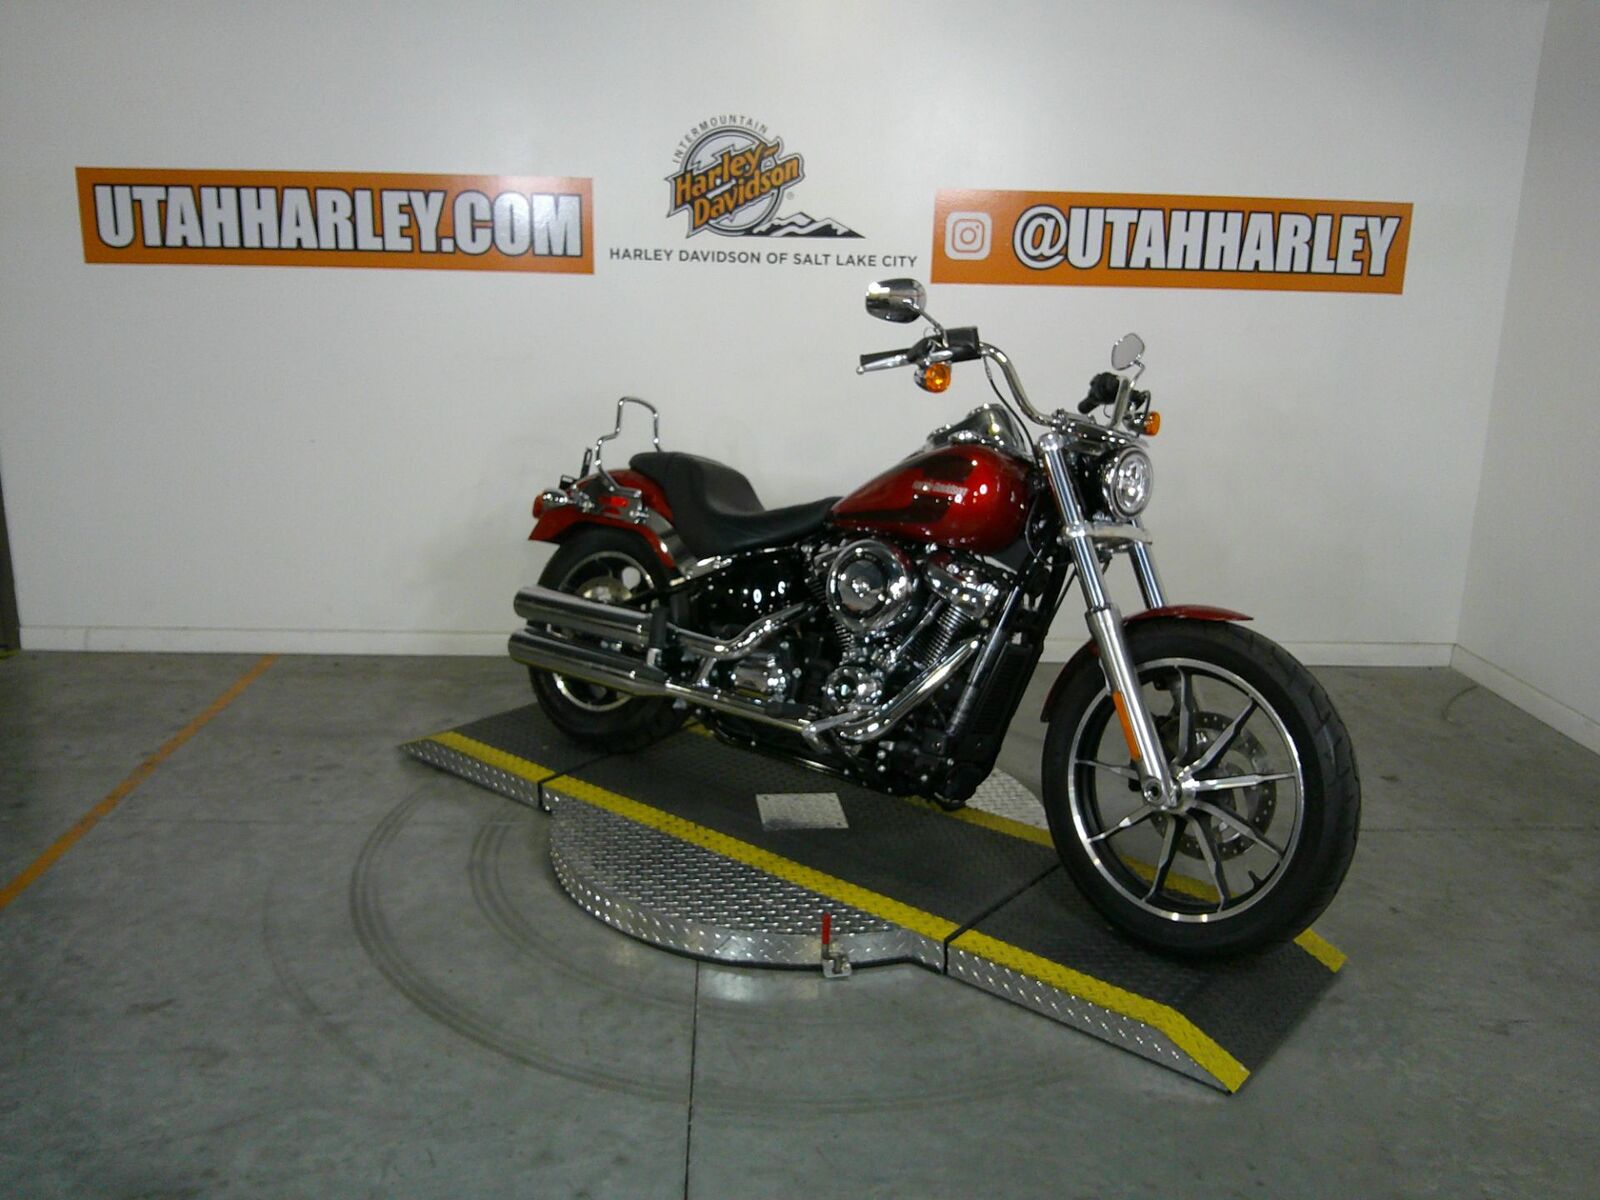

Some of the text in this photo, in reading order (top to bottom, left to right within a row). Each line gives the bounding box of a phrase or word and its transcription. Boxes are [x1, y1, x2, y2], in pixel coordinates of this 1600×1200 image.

[672, 114, 769, 164] INTERMOUNTAIN
[93, 183, 584, 258] UTAHHARLEY.COM
[692, 157, 800, 230] Davidson
[609, 248, 917, 268] HARLEY DAVIDSON OF SALT LAKE CITY
[1012, 203, 1402, 277] @UTAHHARLEY
